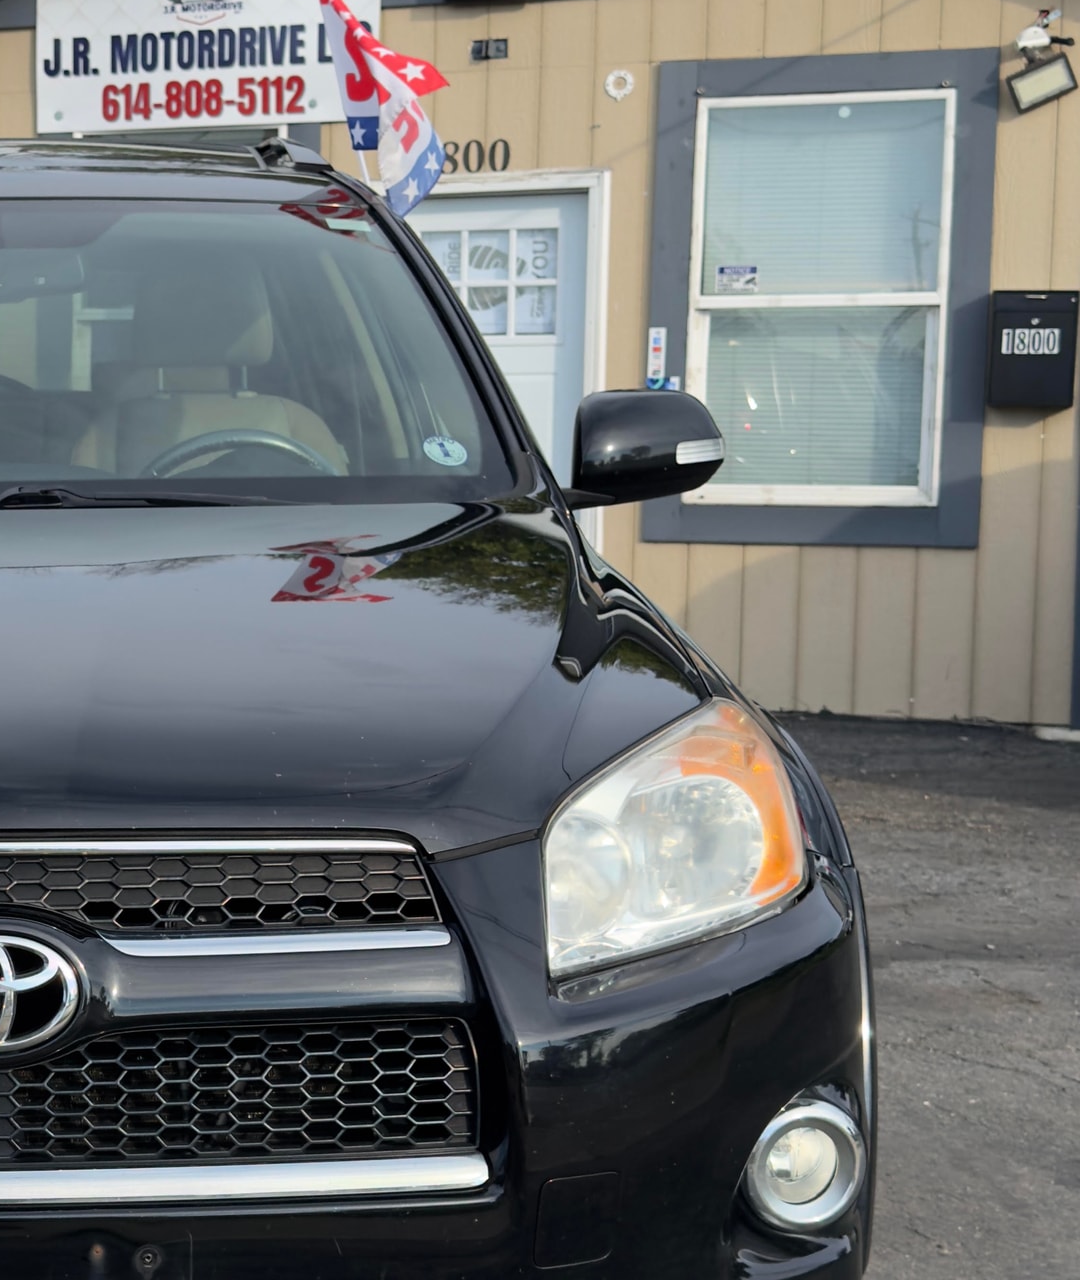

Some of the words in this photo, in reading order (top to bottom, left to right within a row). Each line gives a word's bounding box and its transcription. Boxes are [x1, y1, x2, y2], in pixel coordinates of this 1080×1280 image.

[43, 37, 100, 78] J.R.
[110, 23, 306, 75] MOTORDRIVE
[102, 75, 306, 123] 614-808-5112
[1004, 330, 1057, 352] 1800
